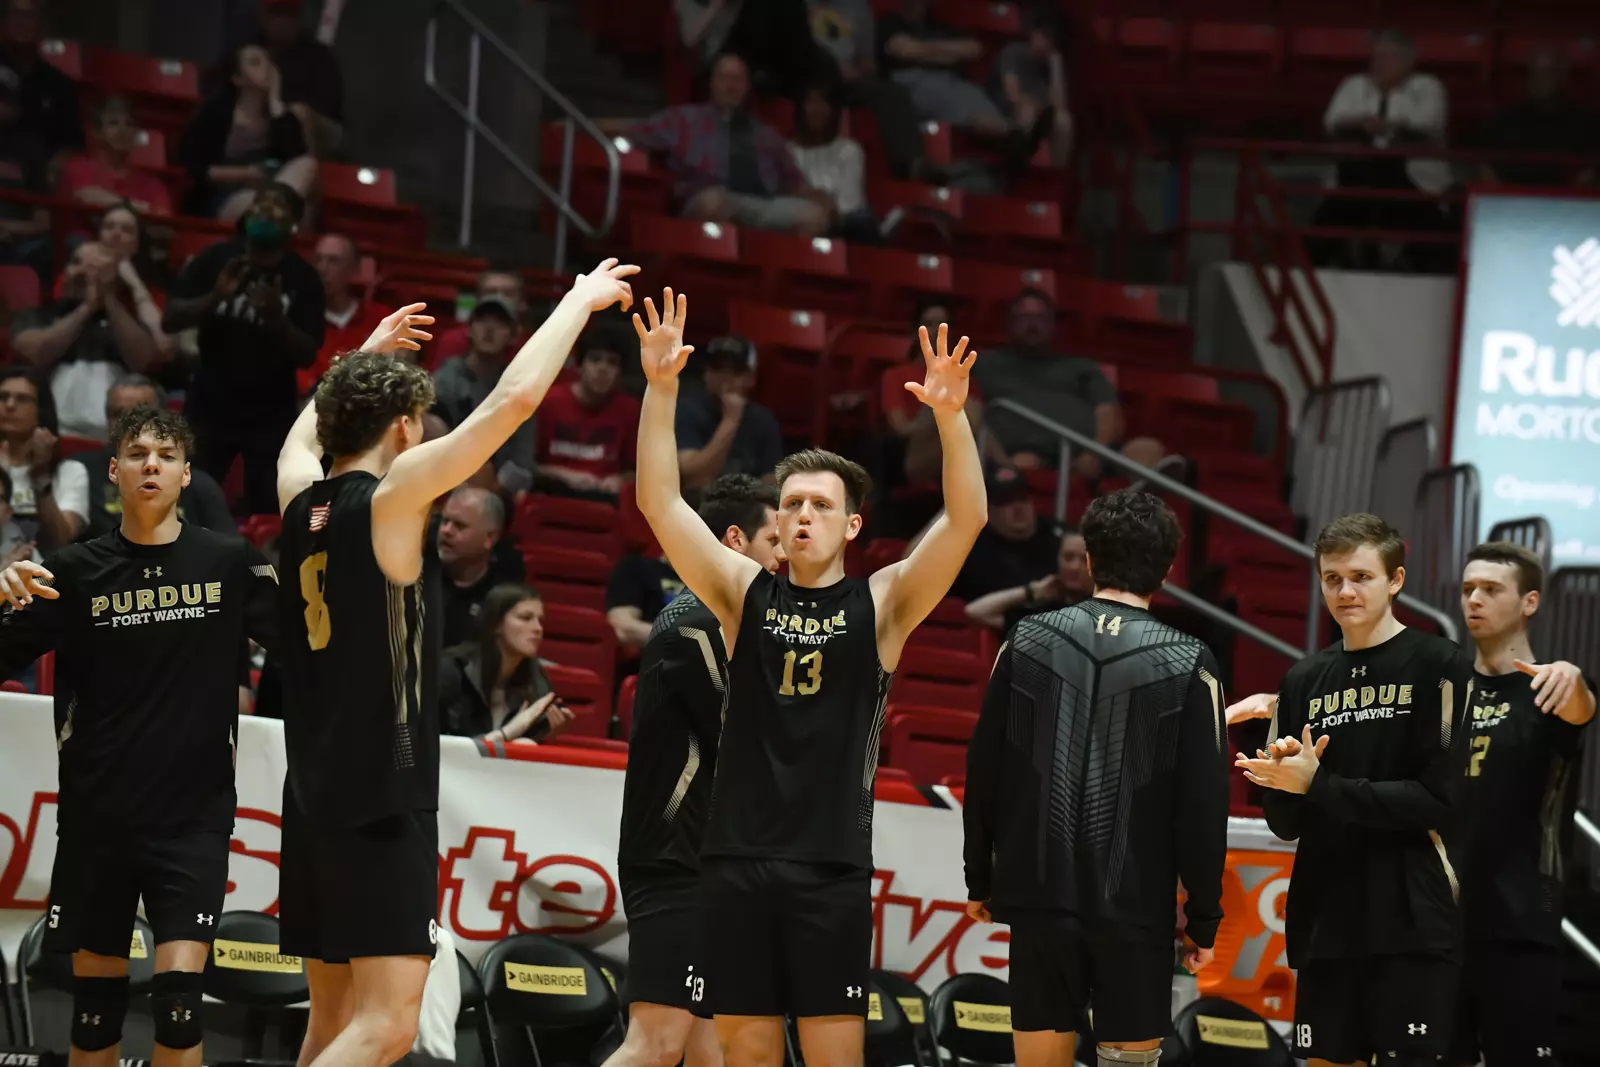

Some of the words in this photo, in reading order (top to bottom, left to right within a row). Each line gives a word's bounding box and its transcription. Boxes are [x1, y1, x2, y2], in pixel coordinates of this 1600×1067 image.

[91, 581, 222, 617] PURDUE
[299, 550, 332, 652] 8
[112, 612, 152, 628] FORT
[153, 606, 206, 622] WAYNE
[1095, 613, 1122, 636] 14
[778, 649, 824, 696] 13
[1308, 683, 1414, 720] PURDUE
[1321, 711, 1352, 729] FORT
[1353, 706, 1395, 722] WAYNE
[1465, 735, 1492, 777] 2
[48, 904, 62, 929] 5
[519, 971, 584, 988] GAINBRIDGE
[691, 976, 705, 1002] 13
[1296, 1023, 1313, 1049] 18
